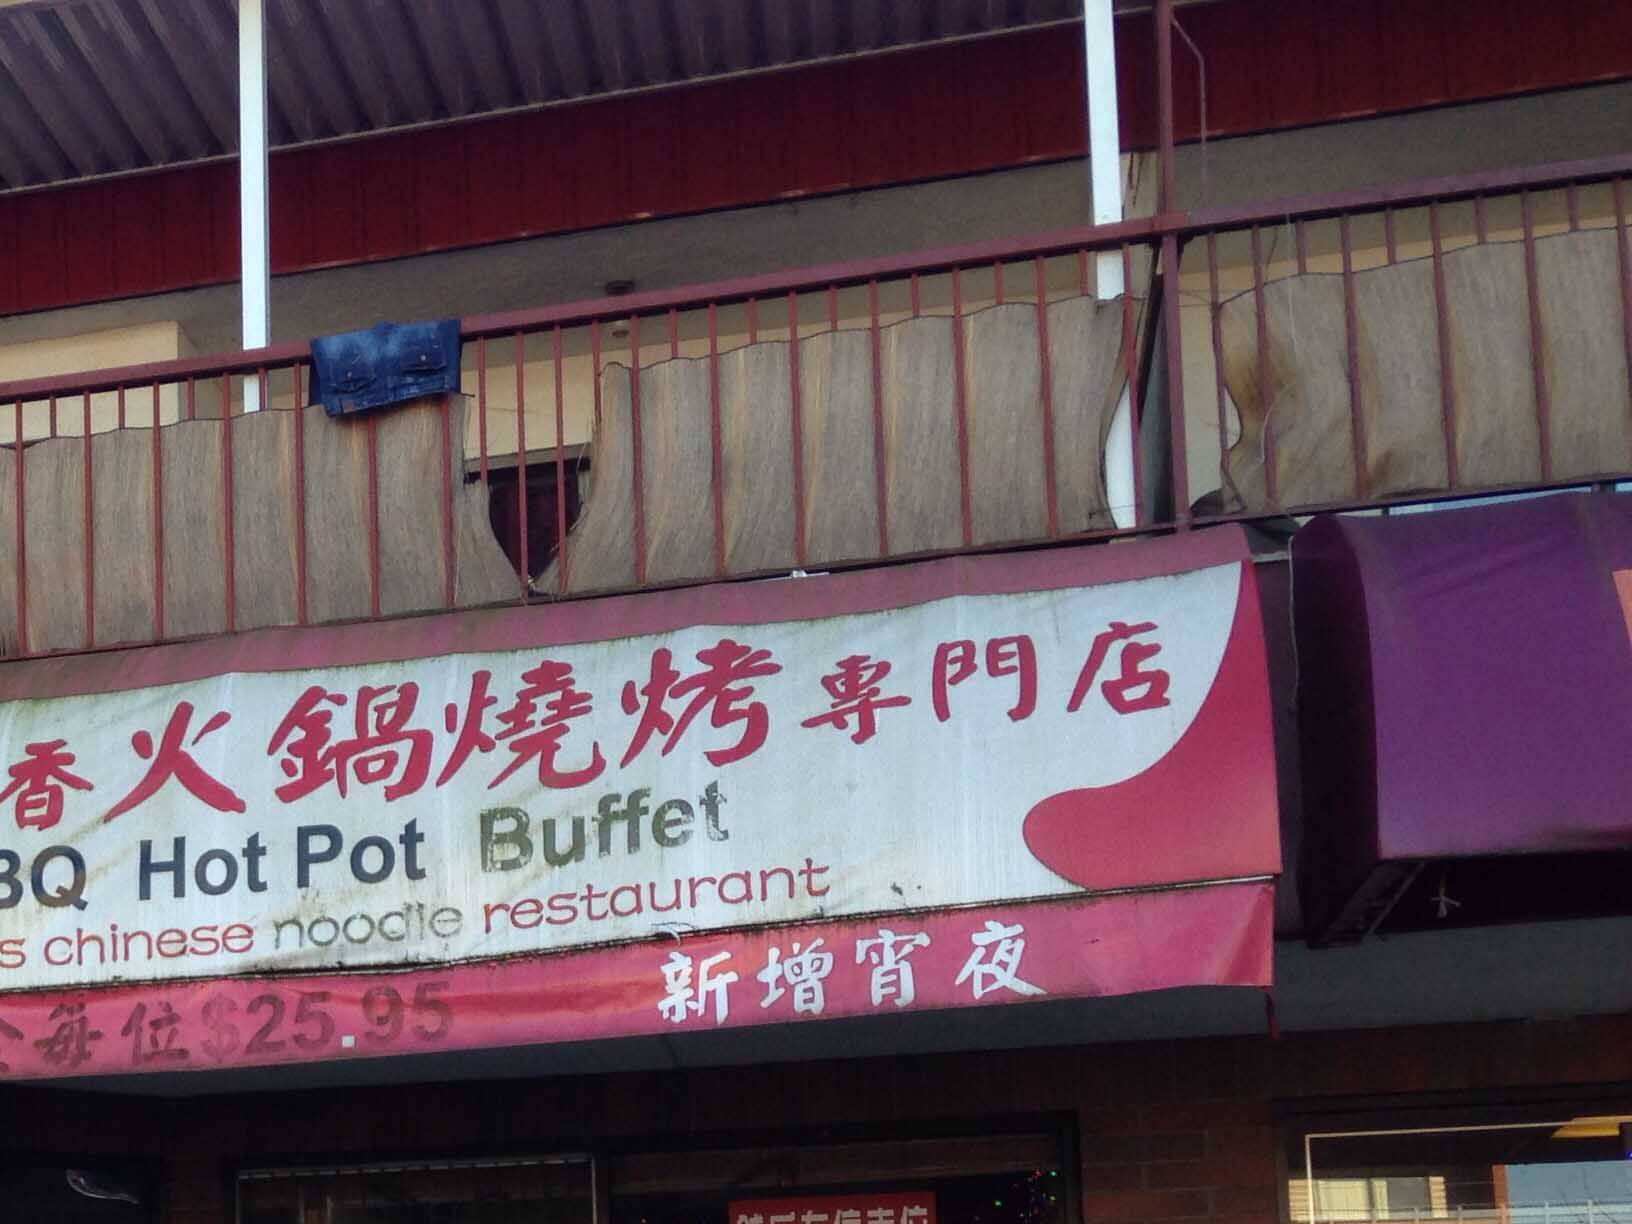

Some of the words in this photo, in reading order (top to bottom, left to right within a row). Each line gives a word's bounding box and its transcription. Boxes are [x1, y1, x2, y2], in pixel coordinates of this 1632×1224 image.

[137, 833, 267, 900] Hot
[296, 819, 426, 889] Pot
[480, 780, 730, 873] Buffet
[43, 921, 254, 967] chinese
[273, 899, 463, 950] noodle
[483, 858, 831, 935] restaurant
[656, 920, 1048, 1024] 新增宵夜
